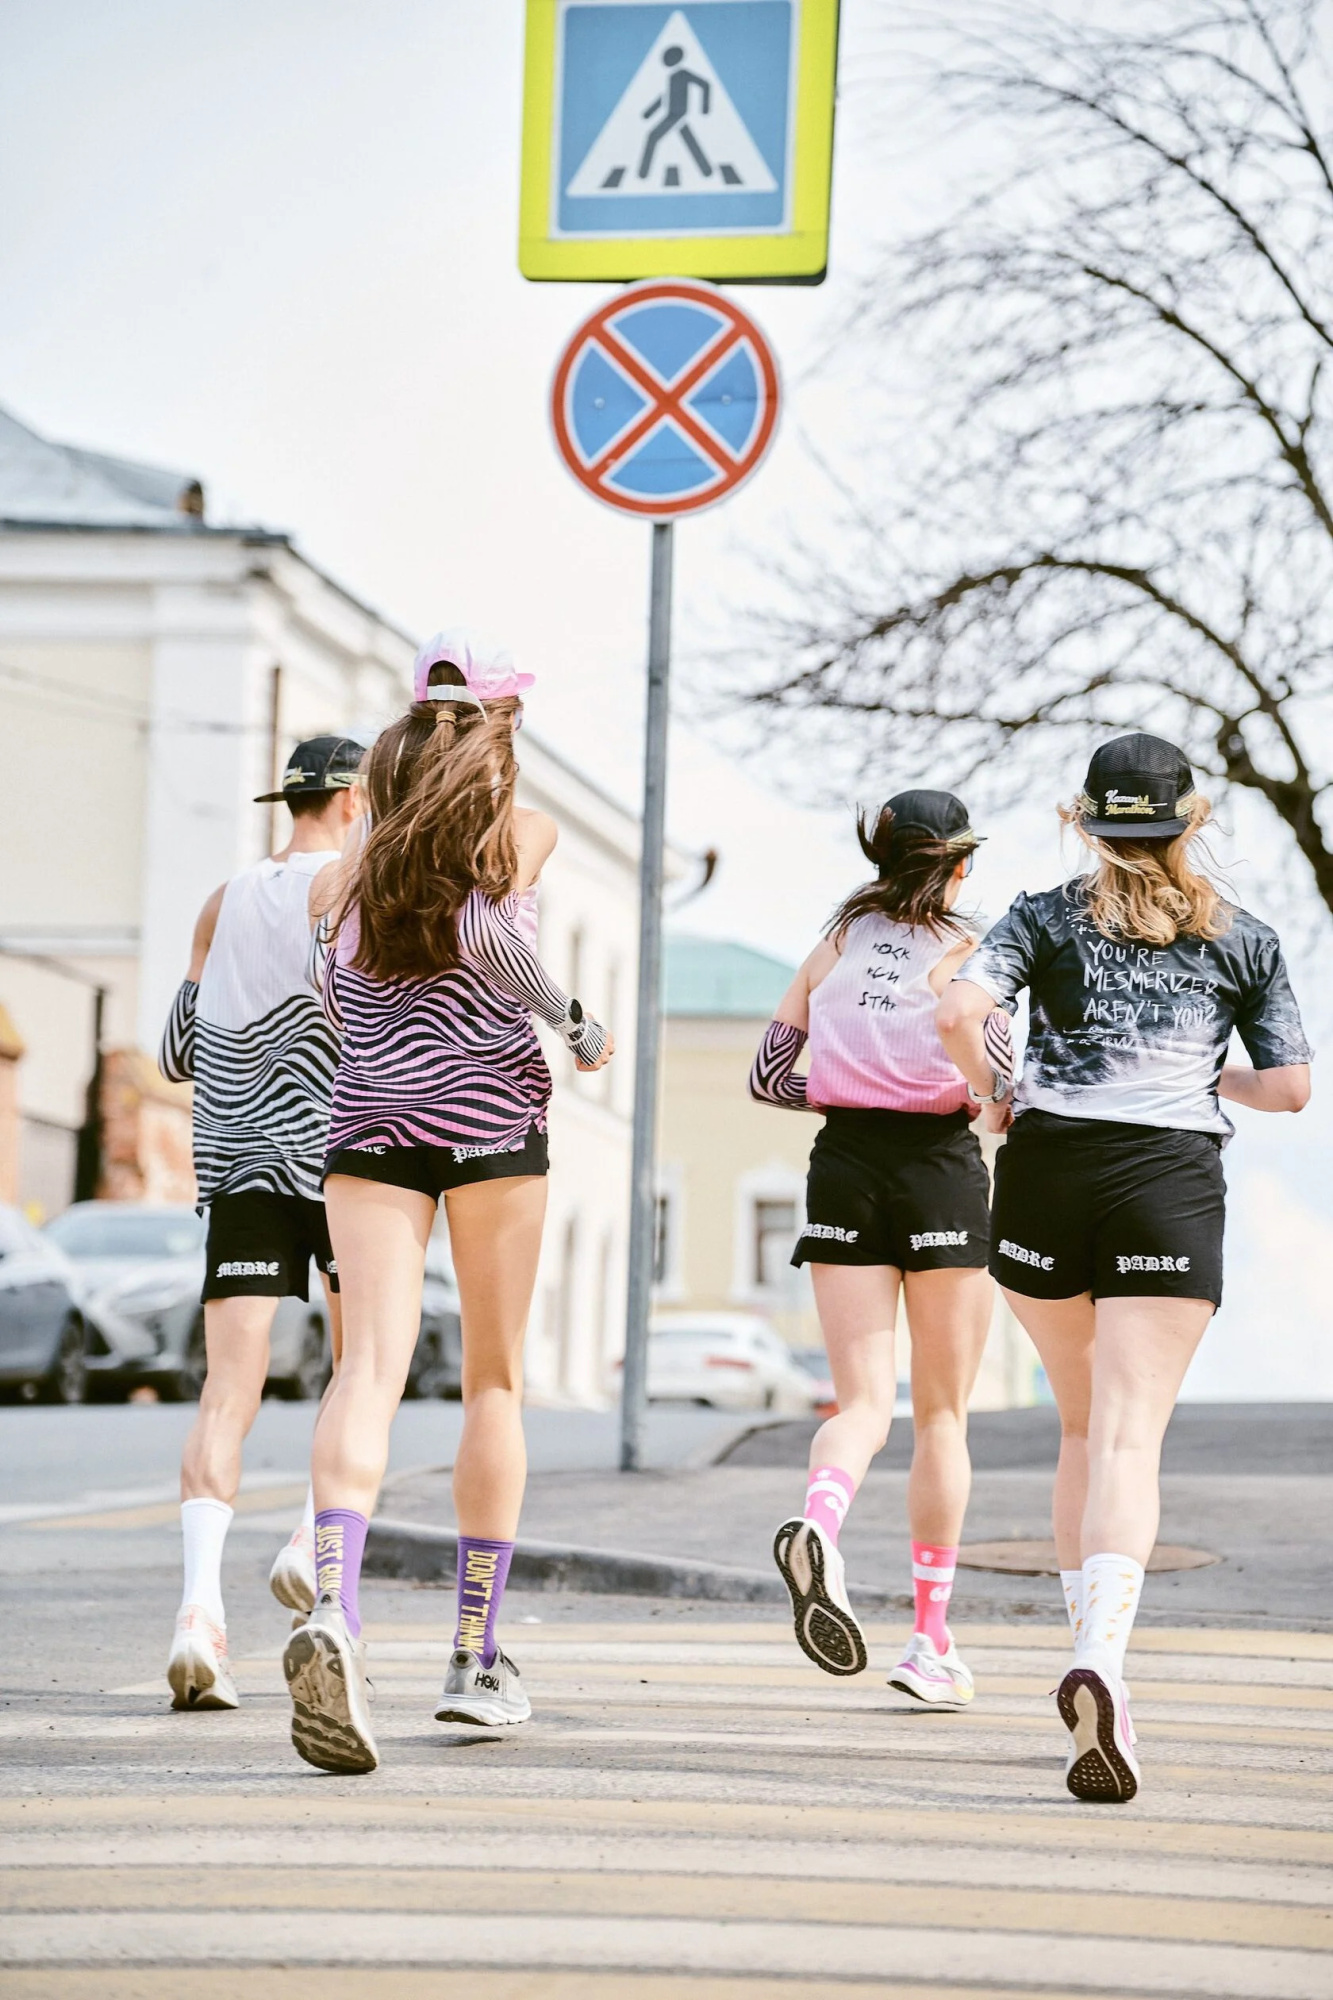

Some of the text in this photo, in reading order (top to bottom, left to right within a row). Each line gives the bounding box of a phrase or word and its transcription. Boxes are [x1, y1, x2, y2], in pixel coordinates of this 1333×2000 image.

[1086, 939, 1168, 967] YOU'RE
[1082, 997, 1166, 1023] AREN'T
[909, 1230, 968, 1251] PADRE
[216, 1261, 280, 1278] MADRE
[1115, 1255, 1191, 1274] PADRE
[315, 1525, 344, 1594] JUST RU
[463, 1549, 499, 1601] DON'T
